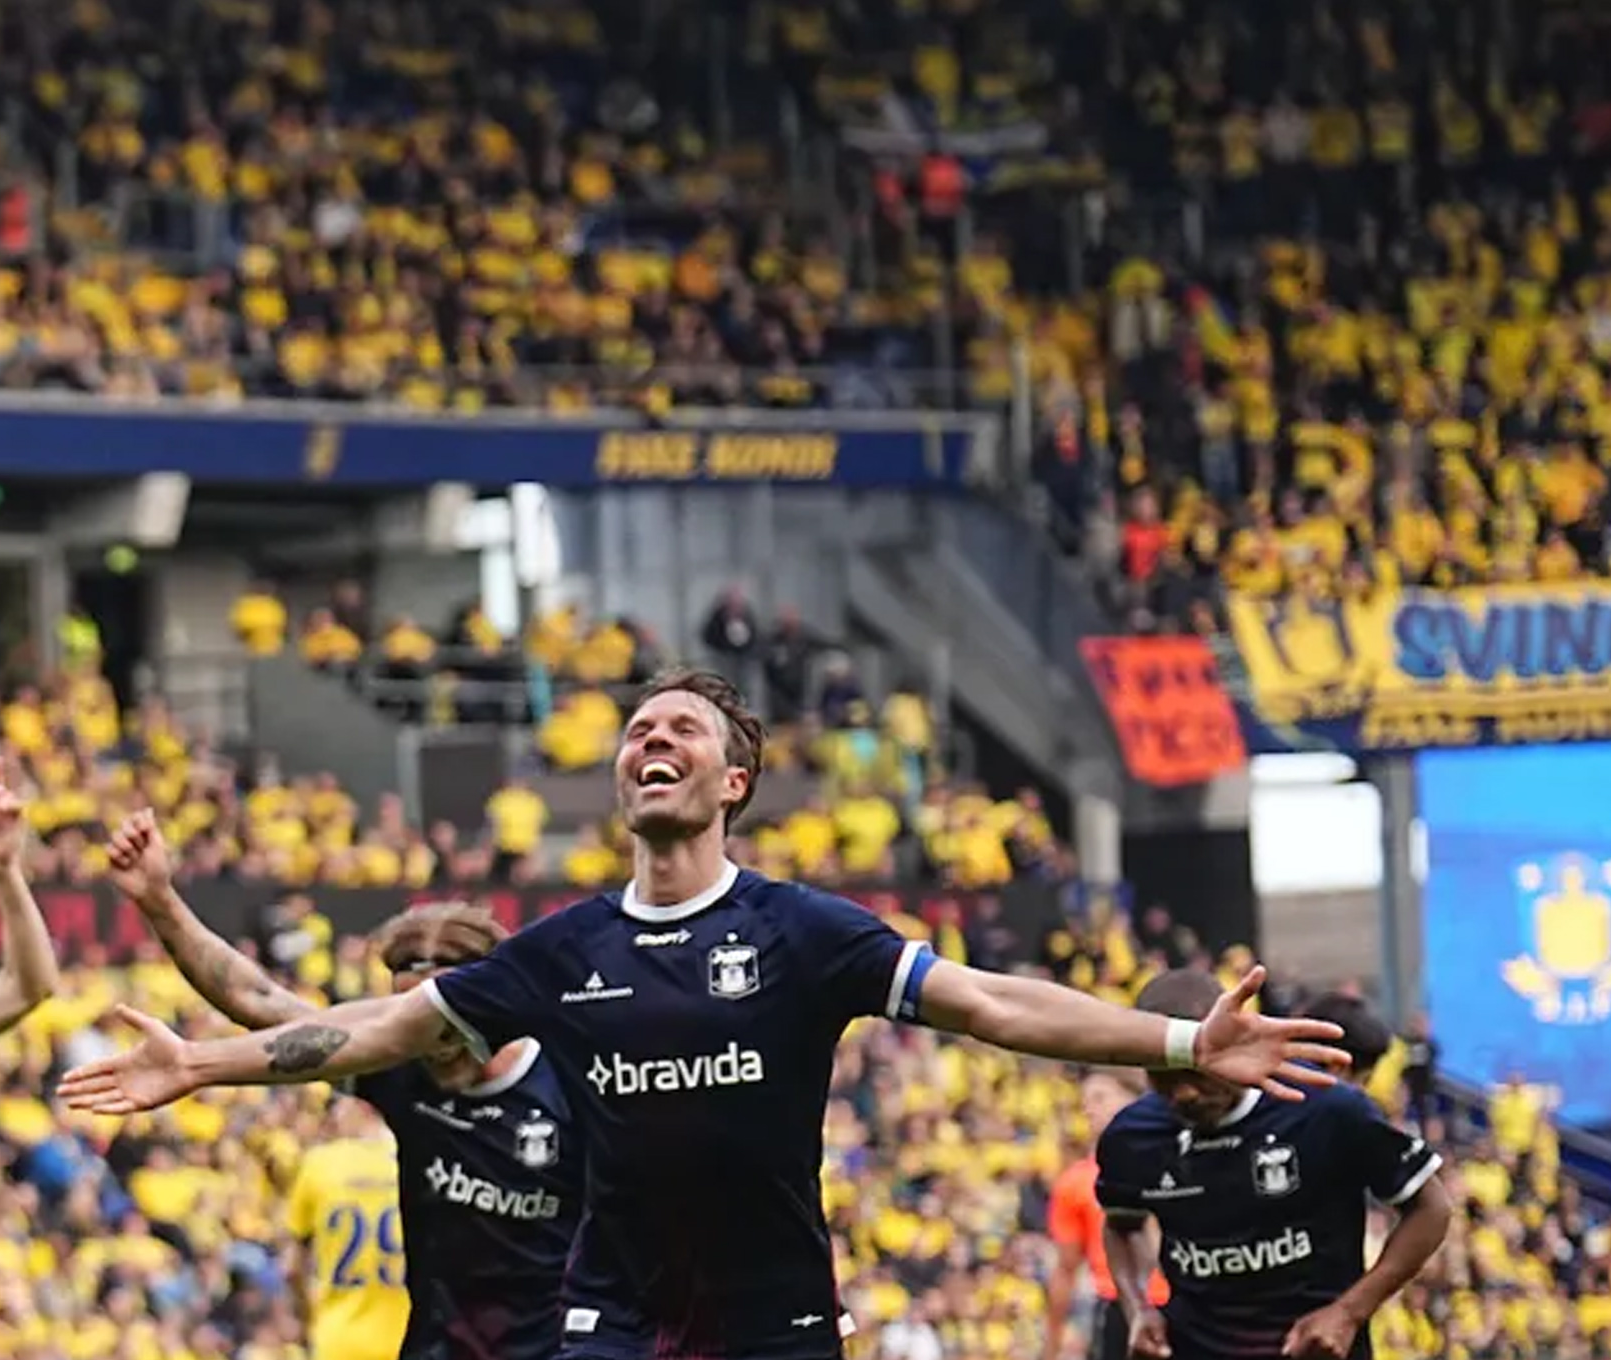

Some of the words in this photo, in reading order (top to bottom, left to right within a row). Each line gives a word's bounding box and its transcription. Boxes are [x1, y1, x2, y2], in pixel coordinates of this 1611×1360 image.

[613, 1041, 764, 1095] bravida
[446, 1162, 560, 1219] bravida
[1188, 1226, 1313, 1278] bravida
